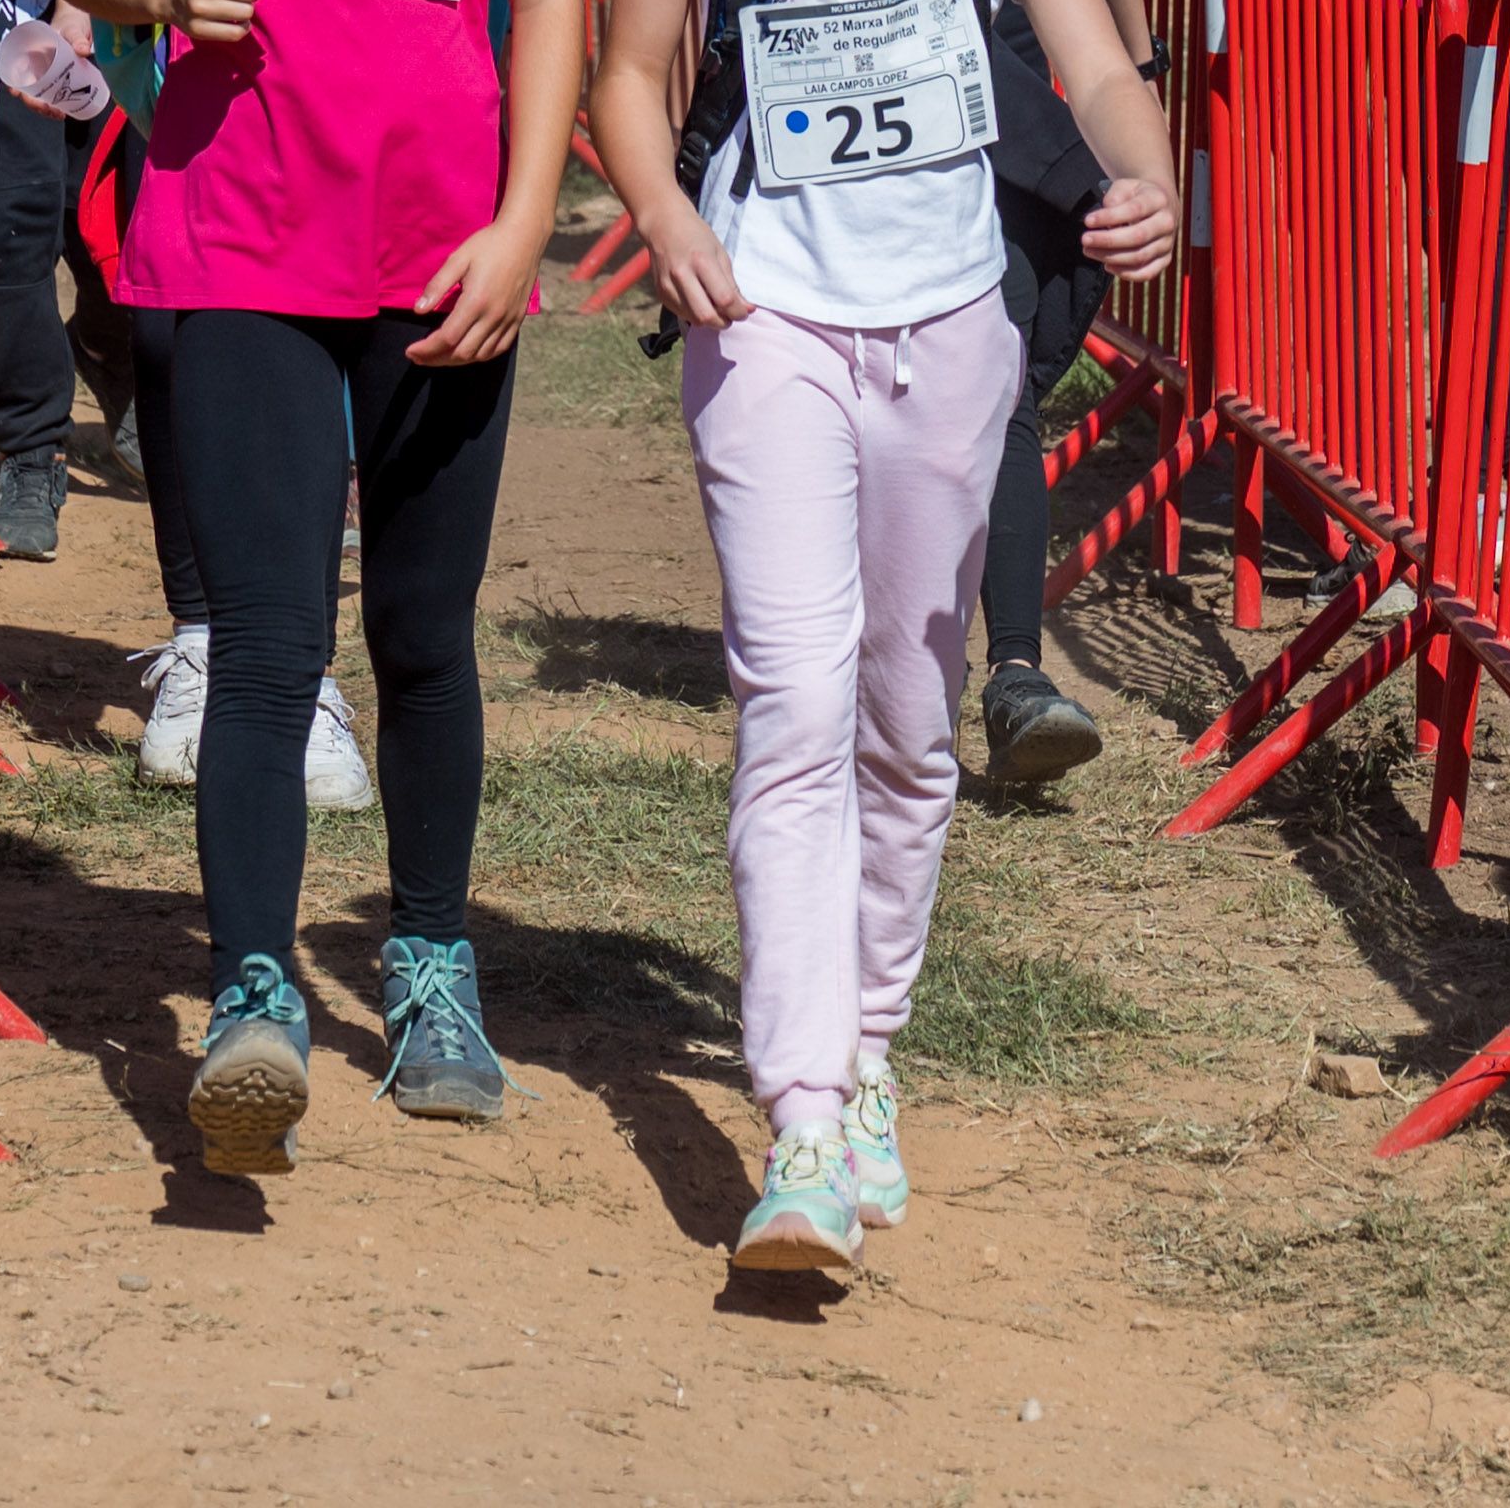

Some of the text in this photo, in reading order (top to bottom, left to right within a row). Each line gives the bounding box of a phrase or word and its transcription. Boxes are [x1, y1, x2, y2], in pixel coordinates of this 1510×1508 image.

[823, 3, 920, 34] 52 Marxa Infantil
[831, 3, 843, 13] NO
[843, 2, 856, 12] EM
[833, 39, 849, 52] de
[853, 24, 917, 50] Regularitat
[804, 70, 908, 95] LAIA CAMPOS LOPEZ
[825, 97, 913, 165] 25
